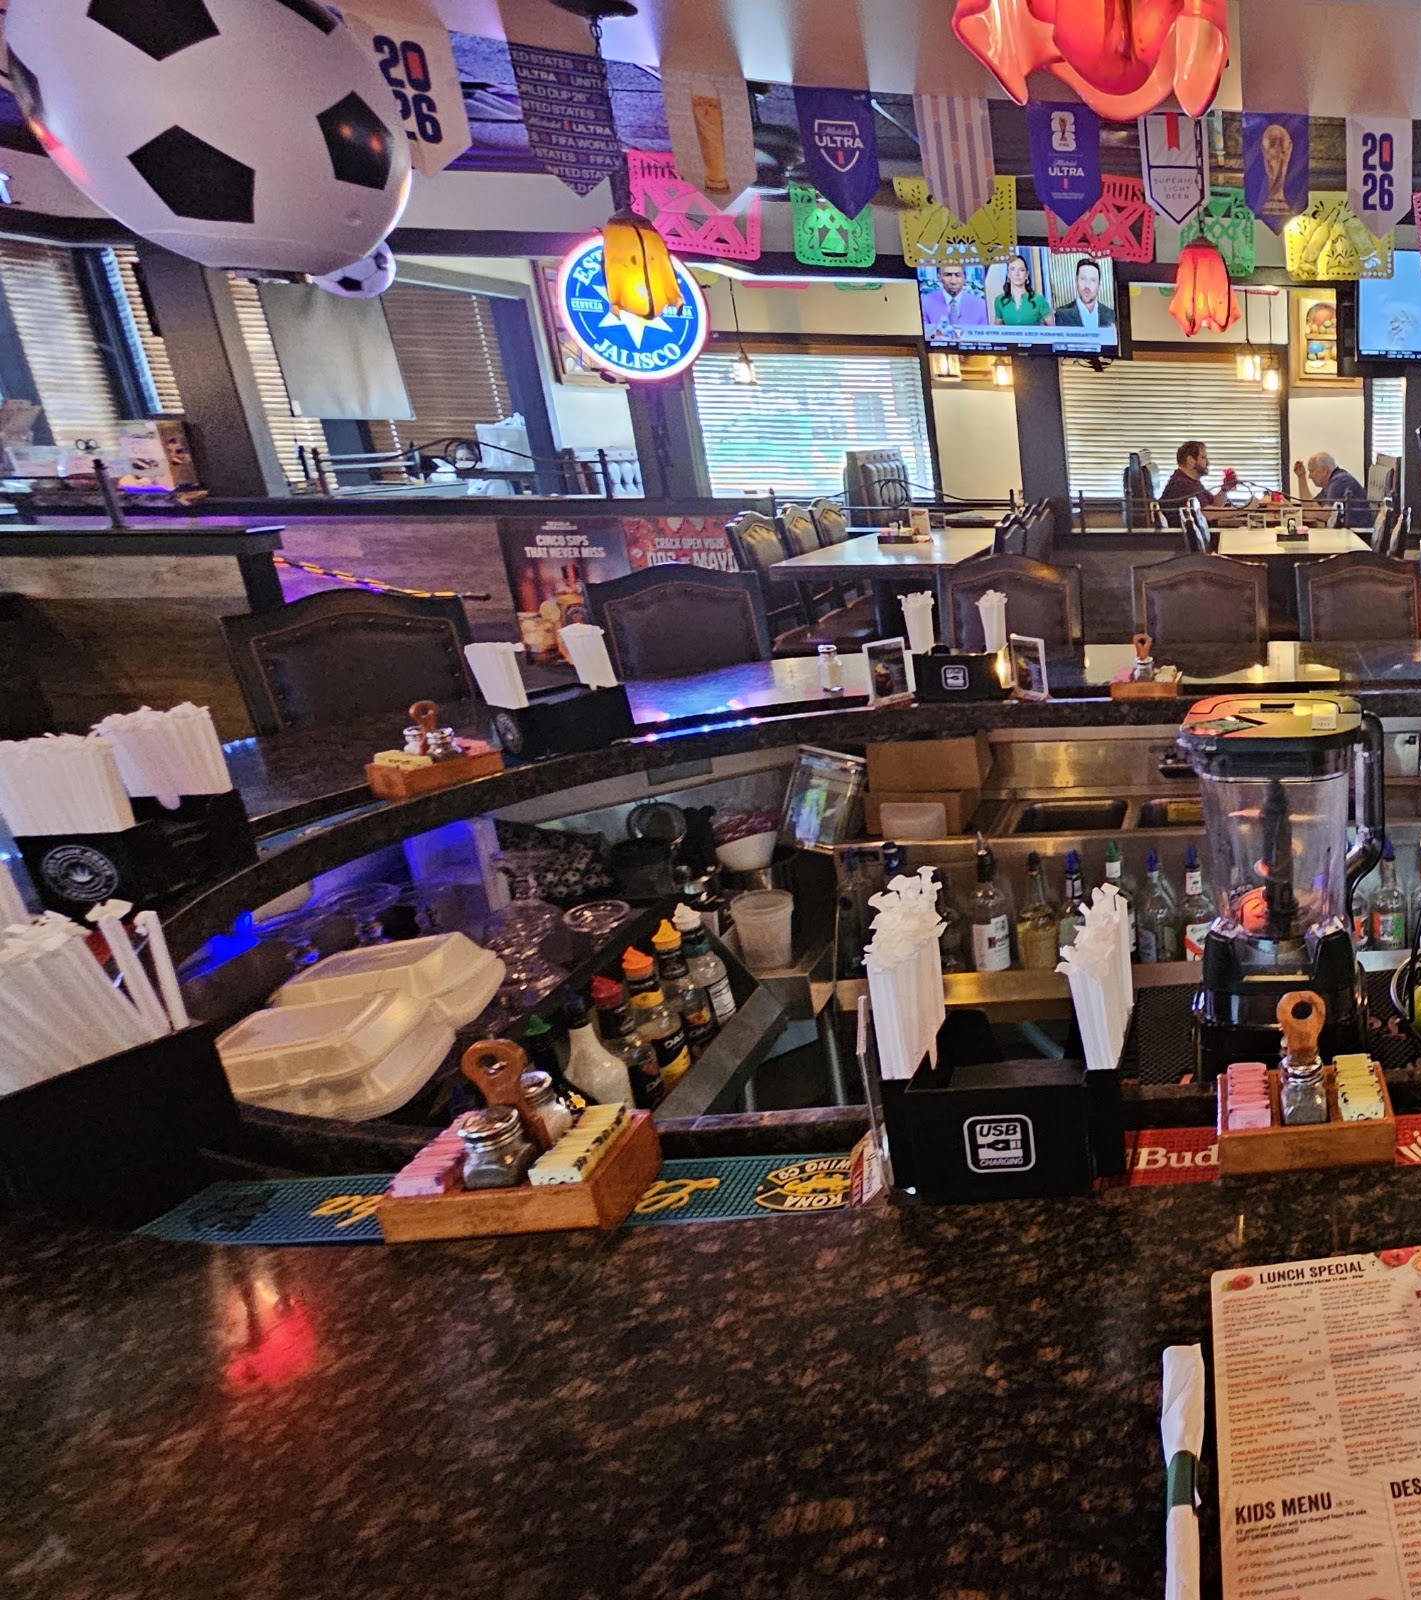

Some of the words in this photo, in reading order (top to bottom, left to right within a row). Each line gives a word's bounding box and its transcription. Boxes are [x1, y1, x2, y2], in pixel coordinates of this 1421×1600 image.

[373, 35, 431, 92] 20
[517, 67, 557, 81] ULTRA
[554, 104, 595, 119] STATES
[572, 124, 612, 136] ULTRA
[551, 135, 576, 146] FIFA
[815, 135, 864, 148] ULTRA
[536, 148, 576, 161] STATES
[1362, 132, 1395, 171] 20
[1048, 167, 1084, 177] ULTRA
[1362, 173, 1394, 212] 26
[594, 339, 681, 369] JALISCO
[535, 535, 565, 546] CINCO
[567, 536, 589, 546] SIPS
[655, 538, 681, 549] CRACK
[682, 538, 702, 549] OPEN
[524, 547, 547, 558] THAT
[549, 547, 580, 558] NEVER
[581, 548, 606, 558] MISS
[979, 1124, 1018, 1137] USB
[980, 1158, 1023, 1167] CHARGING
[784, 1194, 843, 1207] KONA
[1259, 1268, 1306, 1285] LUNCH
[1310, 1261, 1366, 1278] SPECIAL
[1235, 1501, 1276, 1525] KIDS
[1282, 1492, 1332, 1517] MENU
